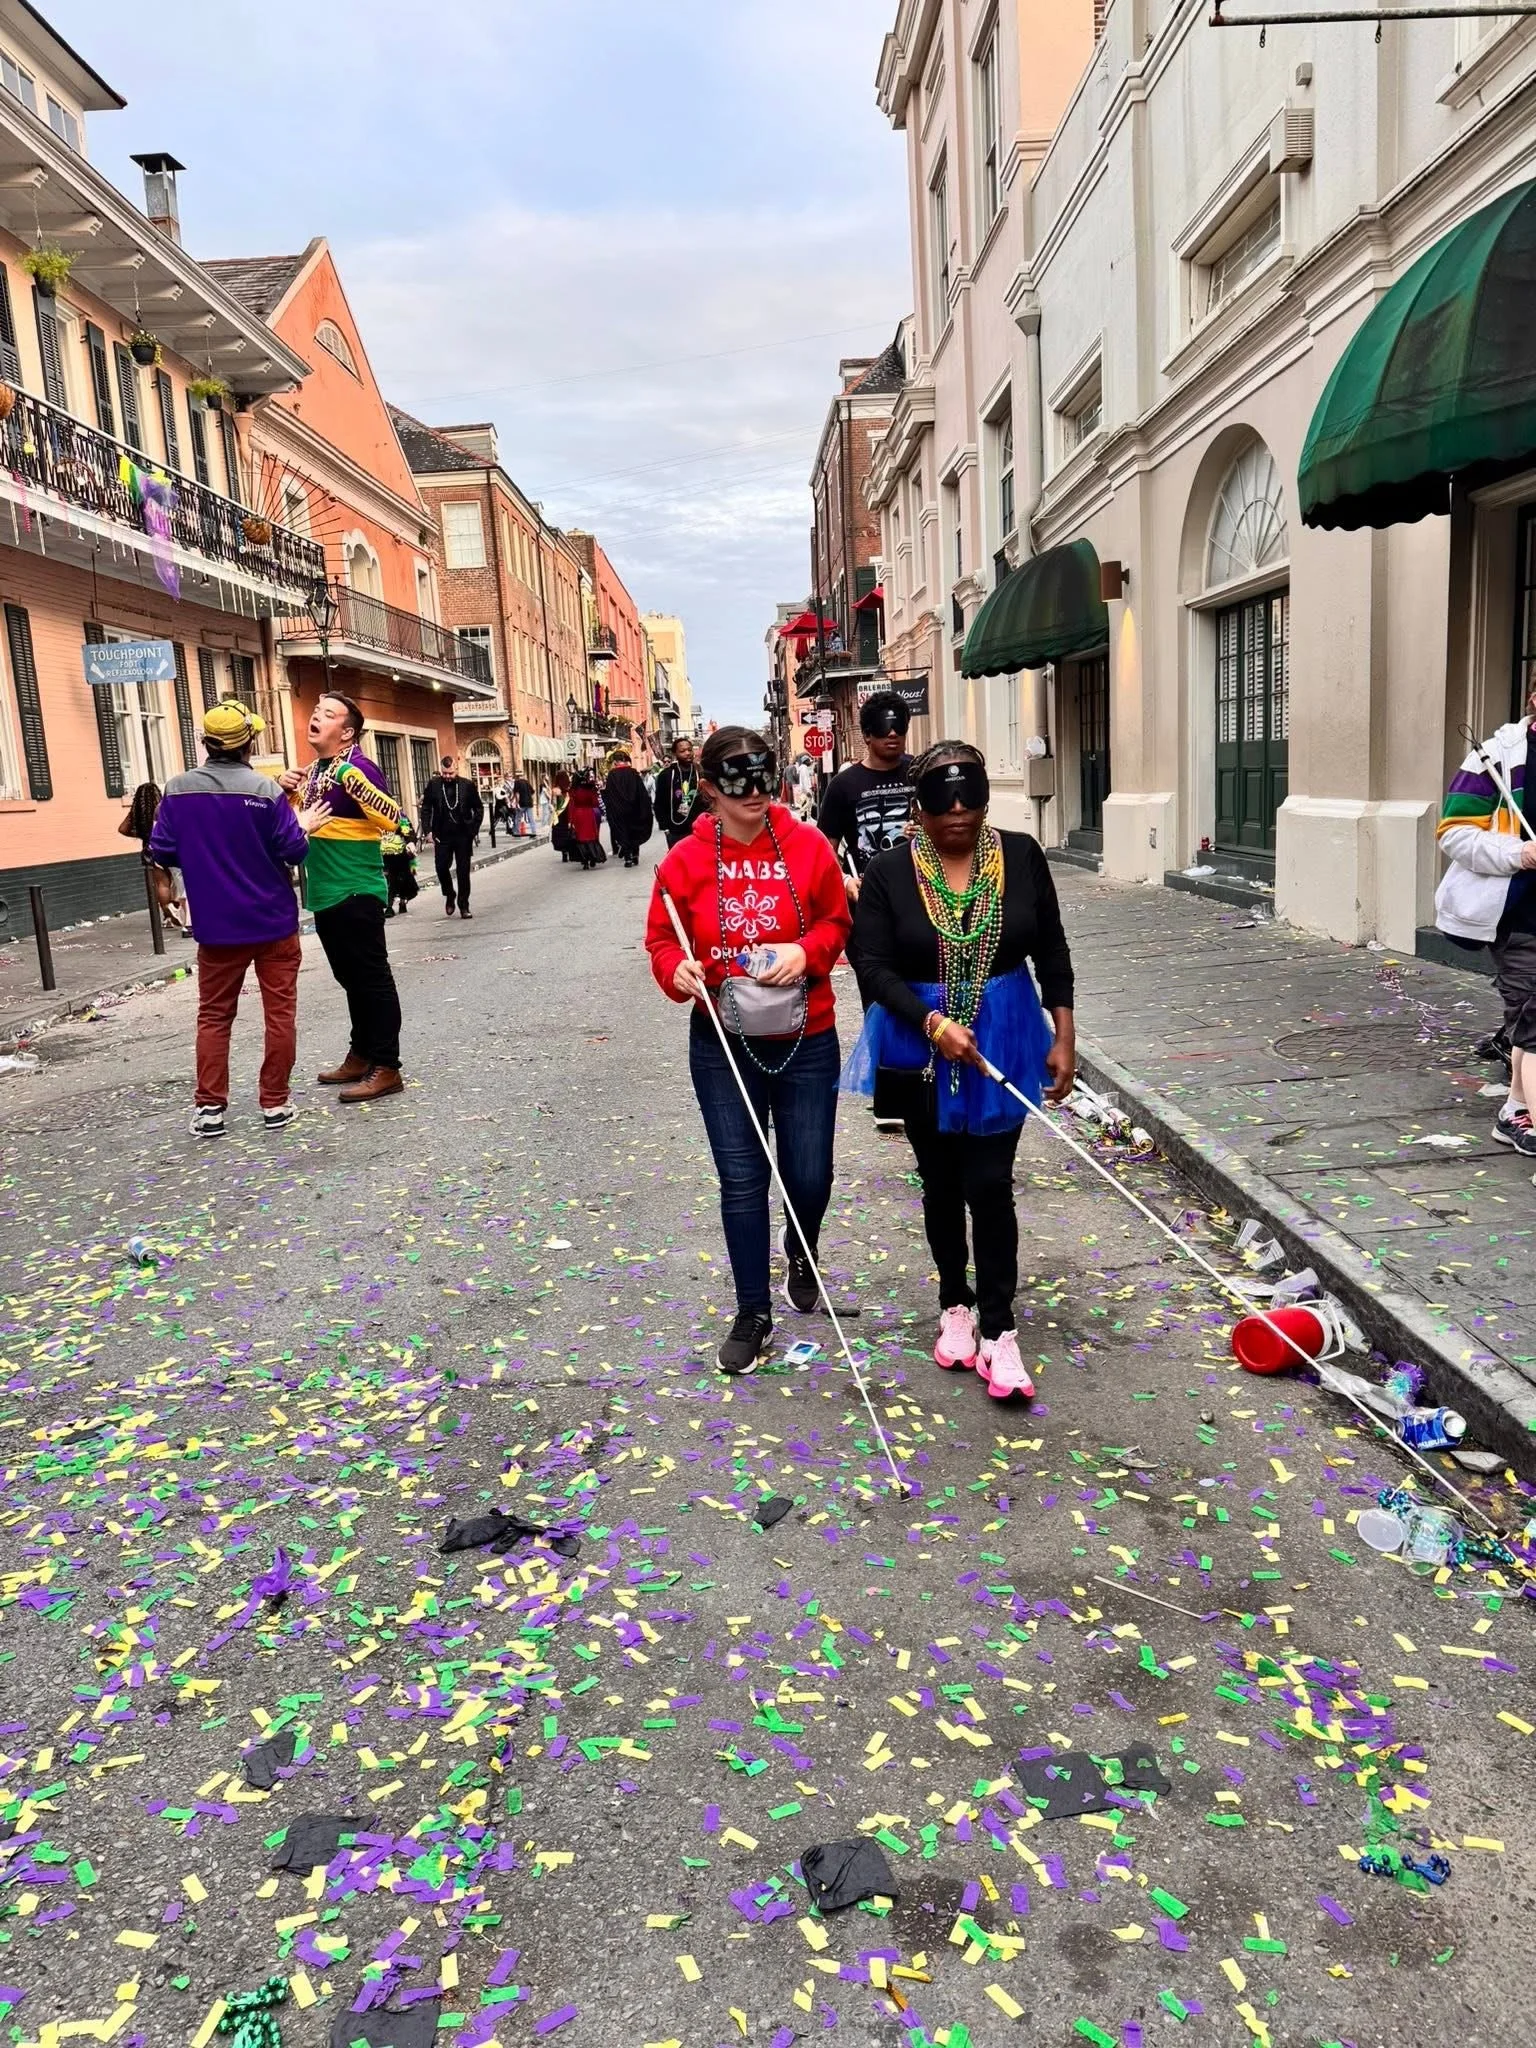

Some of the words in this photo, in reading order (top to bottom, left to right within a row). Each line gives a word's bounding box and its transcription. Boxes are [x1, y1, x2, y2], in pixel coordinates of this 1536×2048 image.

[90, 647, 163, 661] TOUCHPOINT
[119, 660, 138, 668] FOOT
[106, 668, 153, 678] REFLEXOLOGY
[805, 735, 833, 748] STOP
[719, 860, 787, 880] NABS
